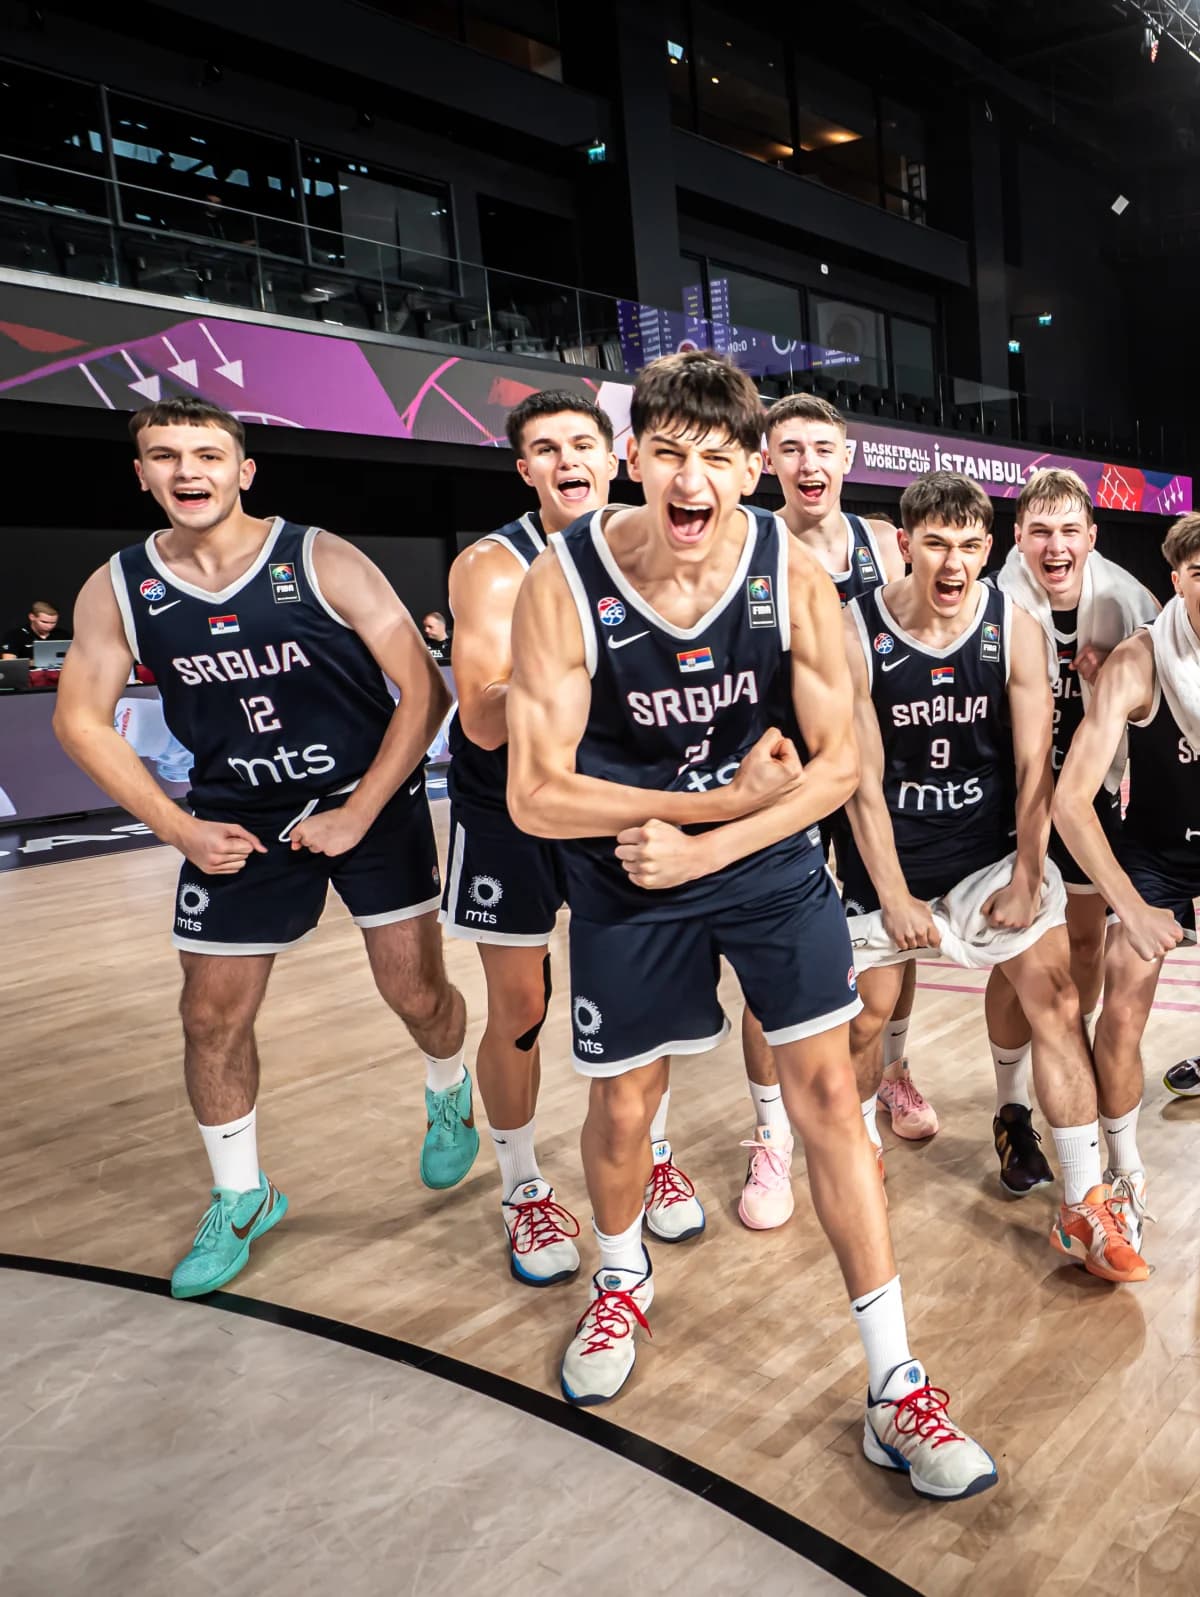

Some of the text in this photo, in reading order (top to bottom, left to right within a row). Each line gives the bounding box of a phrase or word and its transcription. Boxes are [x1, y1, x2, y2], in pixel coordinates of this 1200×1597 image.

[862, 441, 931, 462] BASKETBALL
[864, 453, 931, 473] WORLD CUP
[172, 641, 312, 686] SRBIJA
[240, 696, 282, 734] 12
[891, 695, 988, 727] SRBIJA
[227, 744, 336, 787] mts
[930, 738, 950, 769] 9
[897, 777, 984, 811] mts
[177, 916, 202, 932] mts
[465, 910, 497, 924] mts
